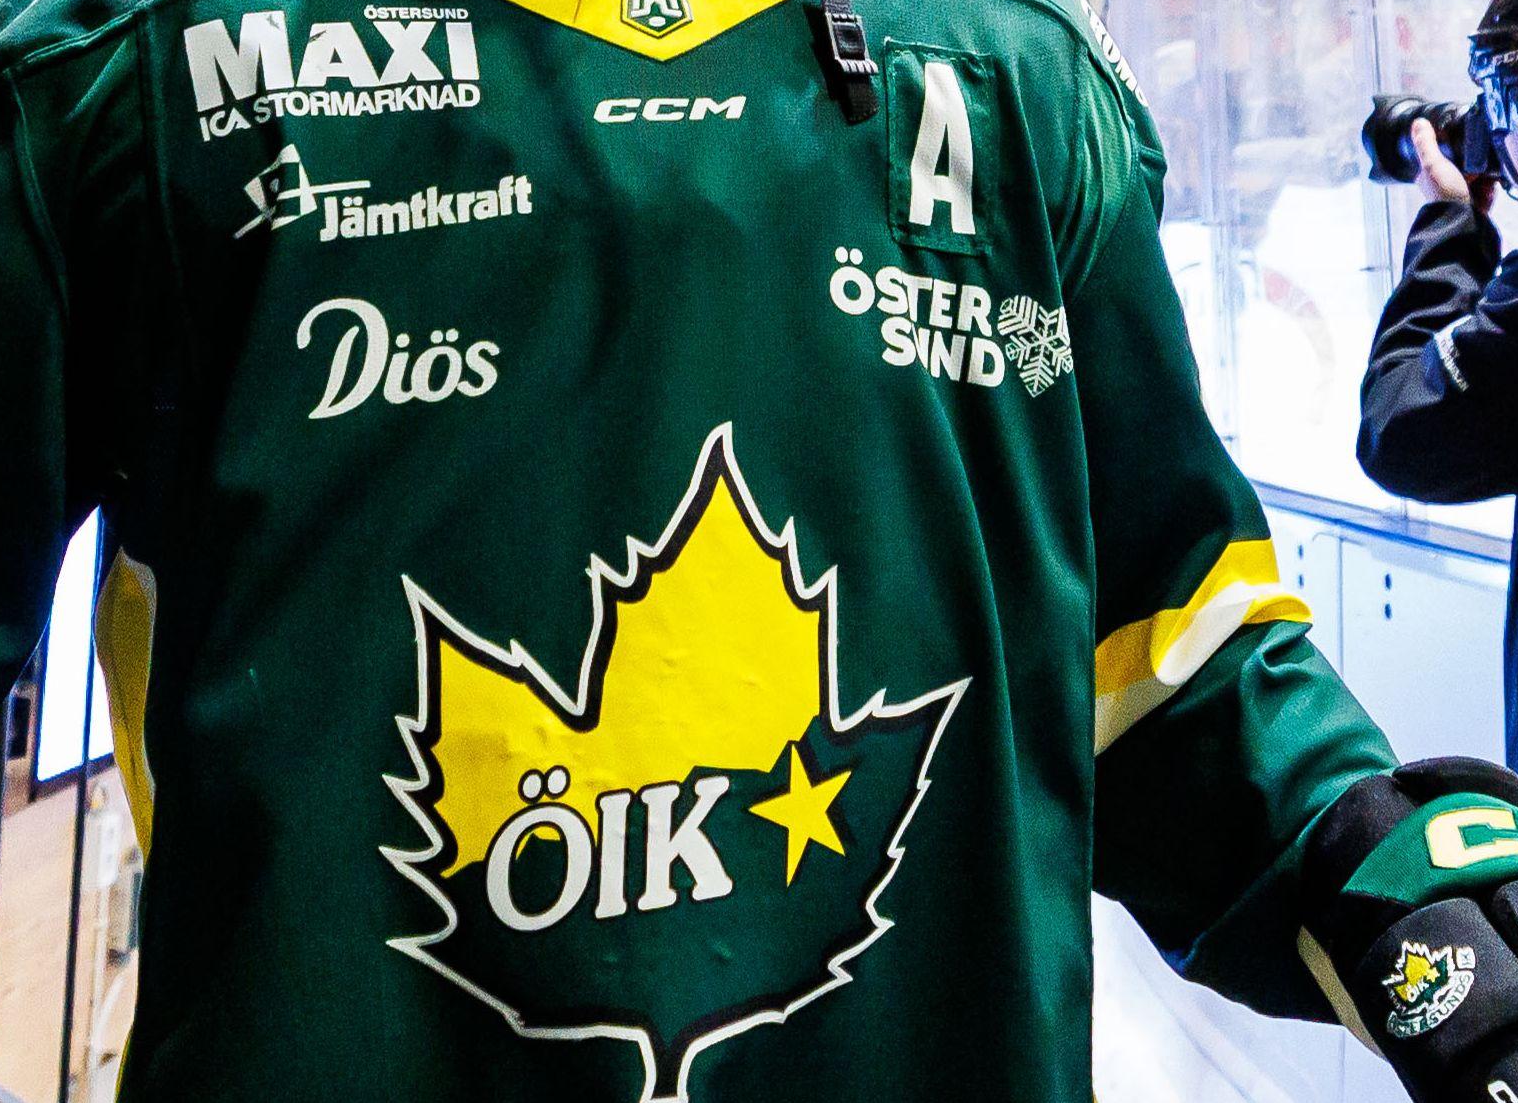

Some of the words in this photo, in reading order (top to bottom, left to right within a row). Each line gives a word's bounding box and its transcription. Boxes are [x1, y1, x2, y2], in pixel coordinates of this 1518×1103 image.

[364, 4, 469, 20] ÖSTERSUND
[184, 10, 480, 113] MAXI
[200, 107, 252, 142] ICA
[253, 83, 481, 124] STORMARKNAD
[593, 96, 746, 123] CCM
[910, 62, 977, 236] A
[319, 176, 533, 242] Jämtkraft
[829, 247, 993, 337] ÖSTER
[296, 297, 500, 419] Diös
[486, 765, 734, 932] ÖIK
